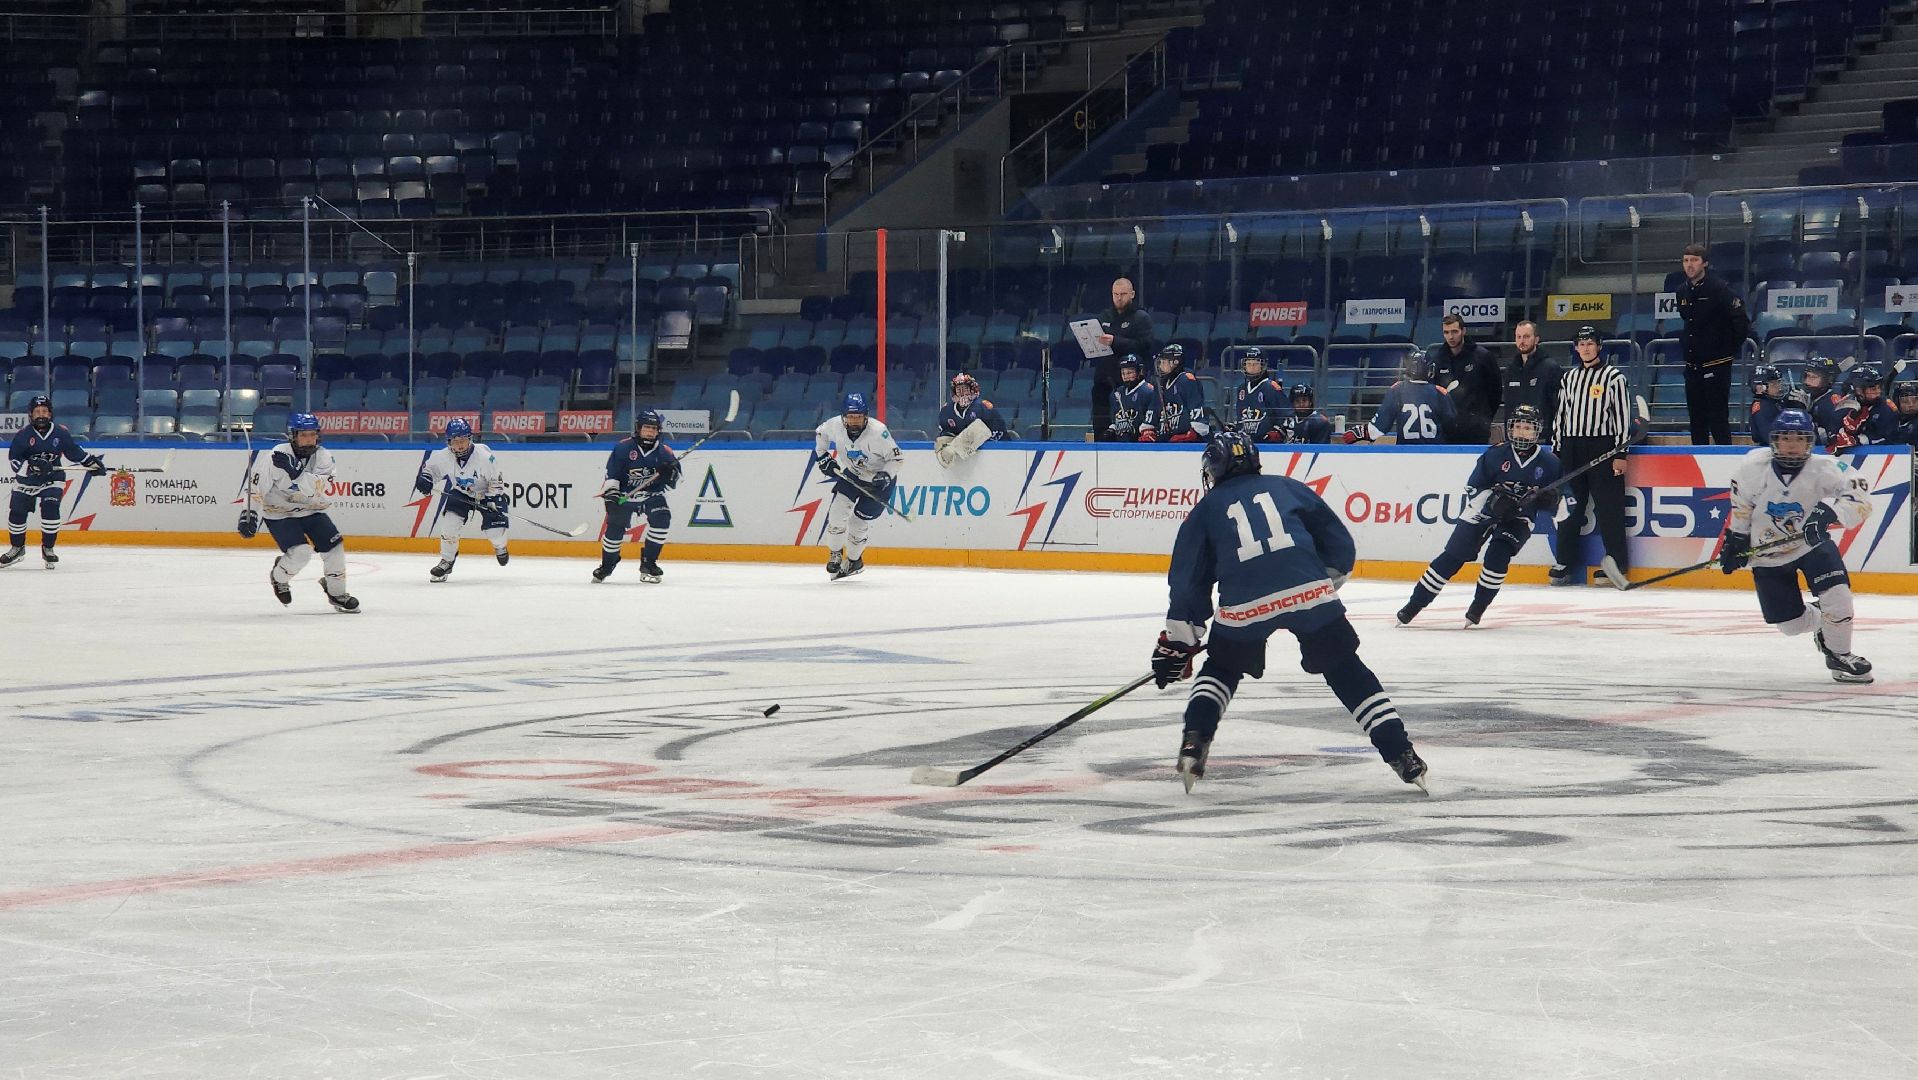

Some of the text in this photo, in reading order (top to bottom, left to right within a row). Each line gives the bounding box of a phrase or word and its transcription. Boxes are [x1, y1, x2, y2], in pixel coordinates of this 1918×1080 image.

[1572, 303, 1604, 312] БАНК
[1776, 294, 1829, 309] SIBUR
[1251, 306, 1307, 321] FONBET
[1362, 307, 1402, 316] ГАЗПРОМБАНК
[317, 414, 408, 430] ONBET FONBET
[429, 415, 479, 430] FOET
[493, 414, 544, 430] FONBET
[560, 414, 611, 430] FONBET
[666, 421, 705, 429] Ростелеком
[1402, 403, 1437, 439] 26
[145, 479, 198, 490] КОМАНДА
[145, 495, 217, 505] ГУБЕРНАТОРА
[1226, 492, 1295, 563] 11
